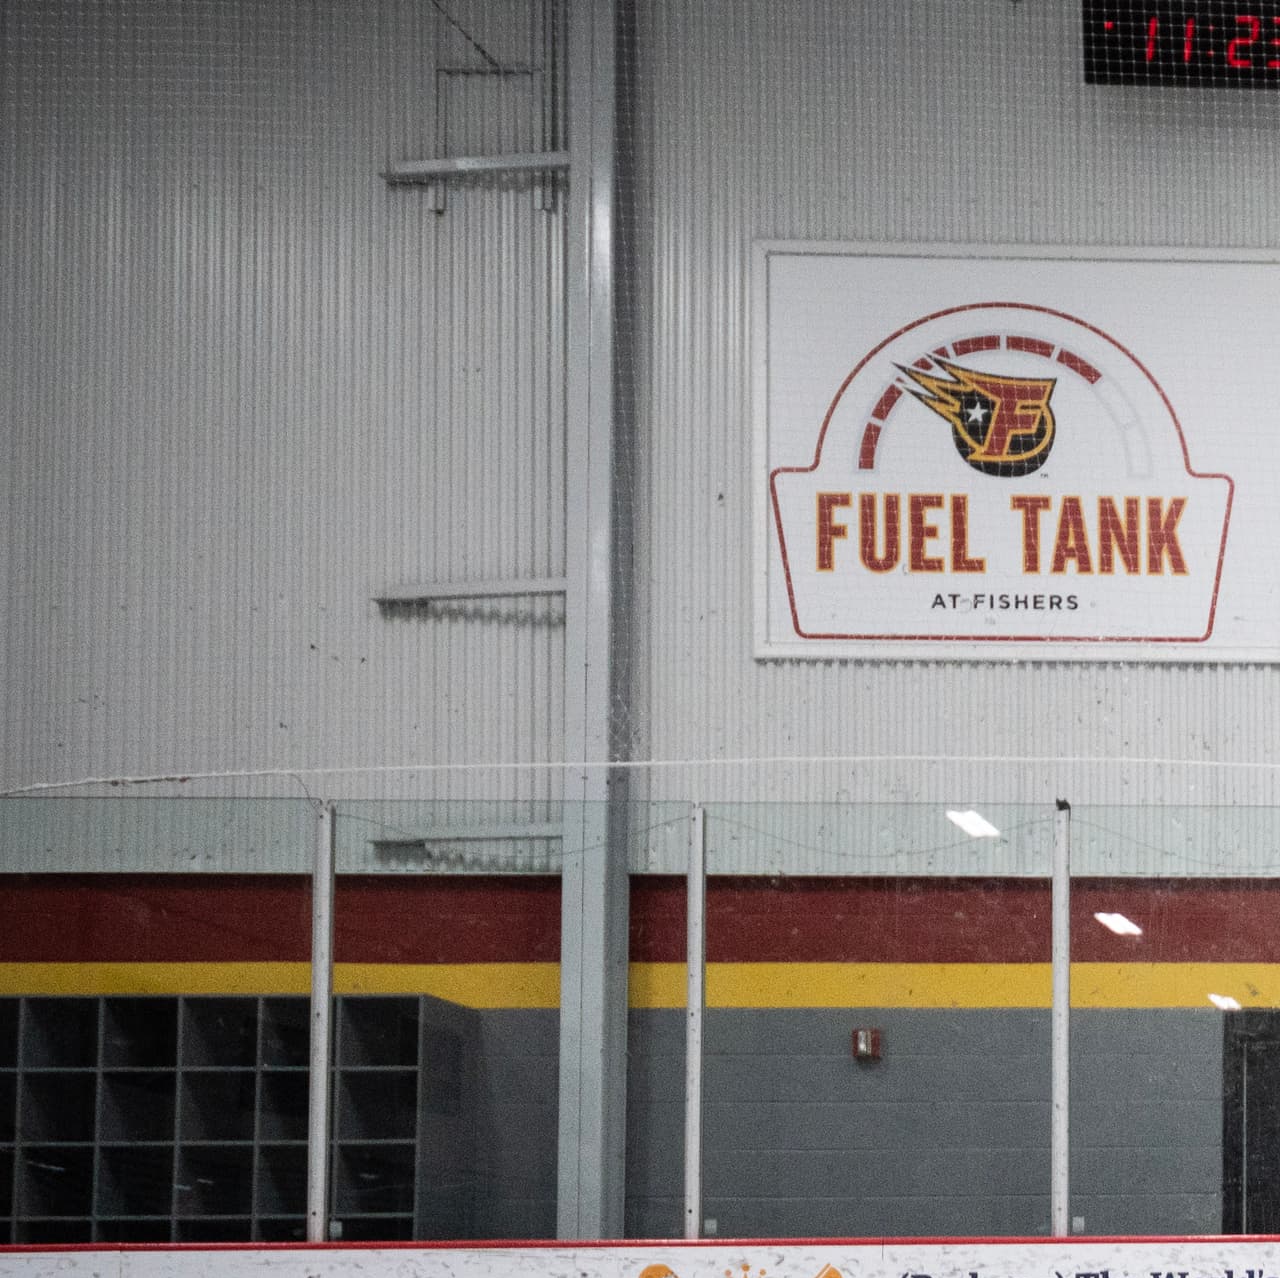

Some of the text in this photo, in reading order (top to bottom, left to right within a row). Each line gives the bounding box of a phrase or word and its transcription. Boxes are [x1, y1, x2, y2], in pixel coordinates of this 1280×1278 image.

[815, 491, 1190, 576] FUEL TANK
[931, 592, 1080, 611] AT FISHERS
